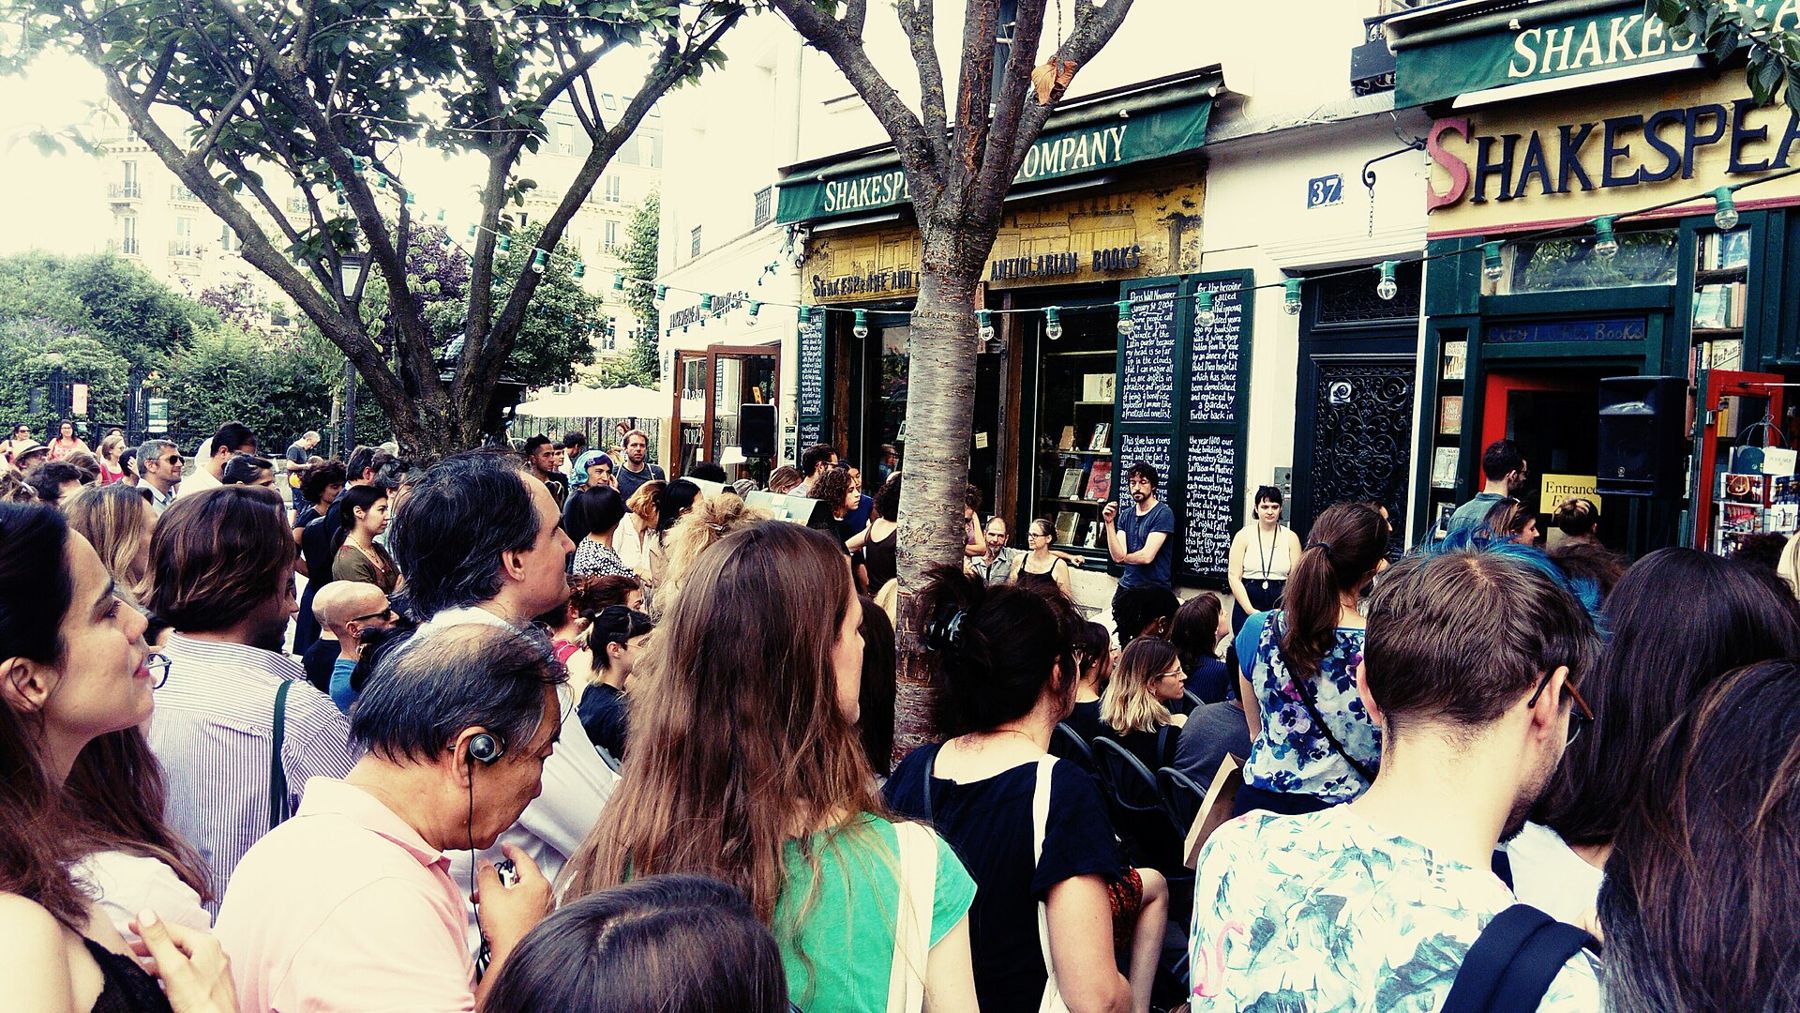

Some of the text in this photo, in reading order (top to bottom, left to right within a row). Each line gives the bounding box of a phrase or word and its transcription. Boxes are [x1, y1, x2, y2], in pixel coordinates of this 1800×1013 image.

[1014, 125, 1127, 178] OMPANY
[1312, 179, 1339, 206] 37
[1092, 243, 1142, 272] BOOKS
[891, 270, 912, 289] AND
[1208, 283, 1219, 292] the
[1158, 300, 1174, 311] 2004
[1132, 312, 1173, 326] Some people call
[1144, 322, 1154, 330] the
[1154, 321, 1167, 330] Don
[1152, 330, 1159, 340] of
[1160, 330, 1170, 338] the
[1205, 327, 1213, 338] my
[1126, 339, 1140, 348] Latin
[1225, 333, 1239, 344] shop
[1227, 341, 1239, 352] Seine
[1126, 350, 1133, 359] my
[1134, 347, 1148, 356] head
[1162, 346, 1171, 357] far
[1192, 353, 1199, 364] by
[1229, 352, 1239, 360] the
[1143, 356, 1152, 364] the
[1153, 356, 1172, 364] clouds
[1125, 365, 1135, 374] that
[1216, 360, 1238, 374] hospital
[1166, 374, 1173, 382] in
[1192, 371, 1237, 381] which has since
[1155, 383, 1173, 391] instead
[1204, 381, 1236, 391] demolished
[1191, 391, 1235, 405] and replaced by
[1210, 410, 1225, 420] back
[1226, 410, 1234, 420] in
[1123, 435, 1134, 445] This
[1146, 436, 1155, 445] has
[1223, 448, 1235, 456] was
[1135, 452, 1144, 461] and
[1153, 453, 1163, 464] fact
[1194, 473, 1215, 483] medieval
[1216, 474, 1233, 485] times
[1187, 499, 1202, 509] whose
[1202, 500, 1218, 513] duty
[1207, 509, 1216, 519] the
[1185, 537, 1196, 546] this
[1196, 537, 1204, 548] for
[1185, 546, 1198, 554] Now
[1214, 550, 1226, 559] my
